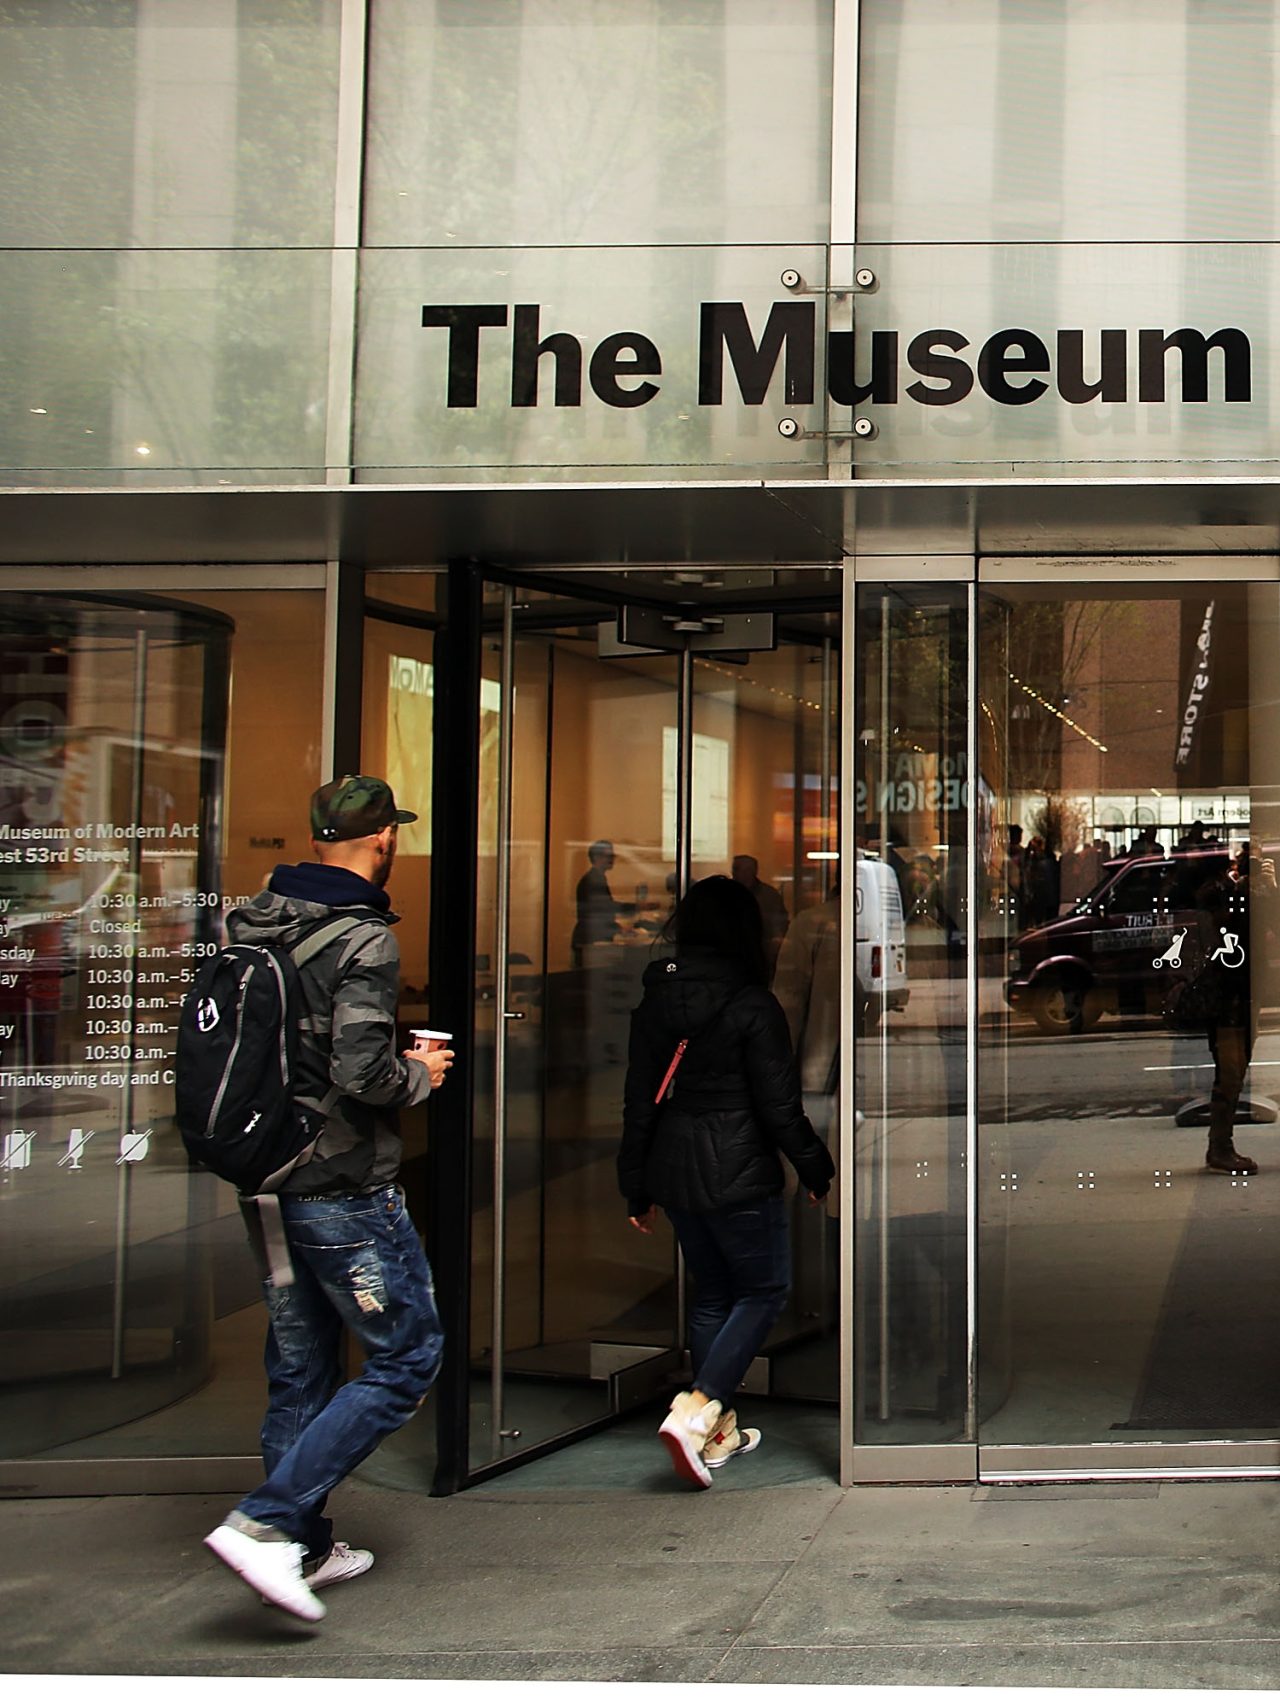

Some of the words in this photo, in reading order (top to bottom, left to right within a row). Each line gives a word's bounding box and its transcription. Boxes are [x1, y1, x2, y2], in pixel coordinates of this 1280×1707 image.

[422, 302, 661, 408] The
[698, 301, 1252, 405] Museum
[75, 823, 93, 839] of
[97, 823, 165, 839] Modern
[169, 823, 199, 839] Art
[26, 848, 69, 864] 53rd
[74, 847, 130, 863] Street
[91, 894, 135, 909] 10:30
[90, 920, 141, 934] Closed
[89, 944, 134, 959] 10:30
[88, 970, 133, 984] 10:30
[137, 969, 202, 983] a.m.–5:
[87, 995, 132, 1009] 10:30
[86, 1020, 131, 1035] 10:30
[85, 1046, 131, 1060] 10:30
[0, 1072, 97, 1089] Thanksgiving
[101, 1070, 128, 1087] day
[131, 1070, 159, 1086] and
